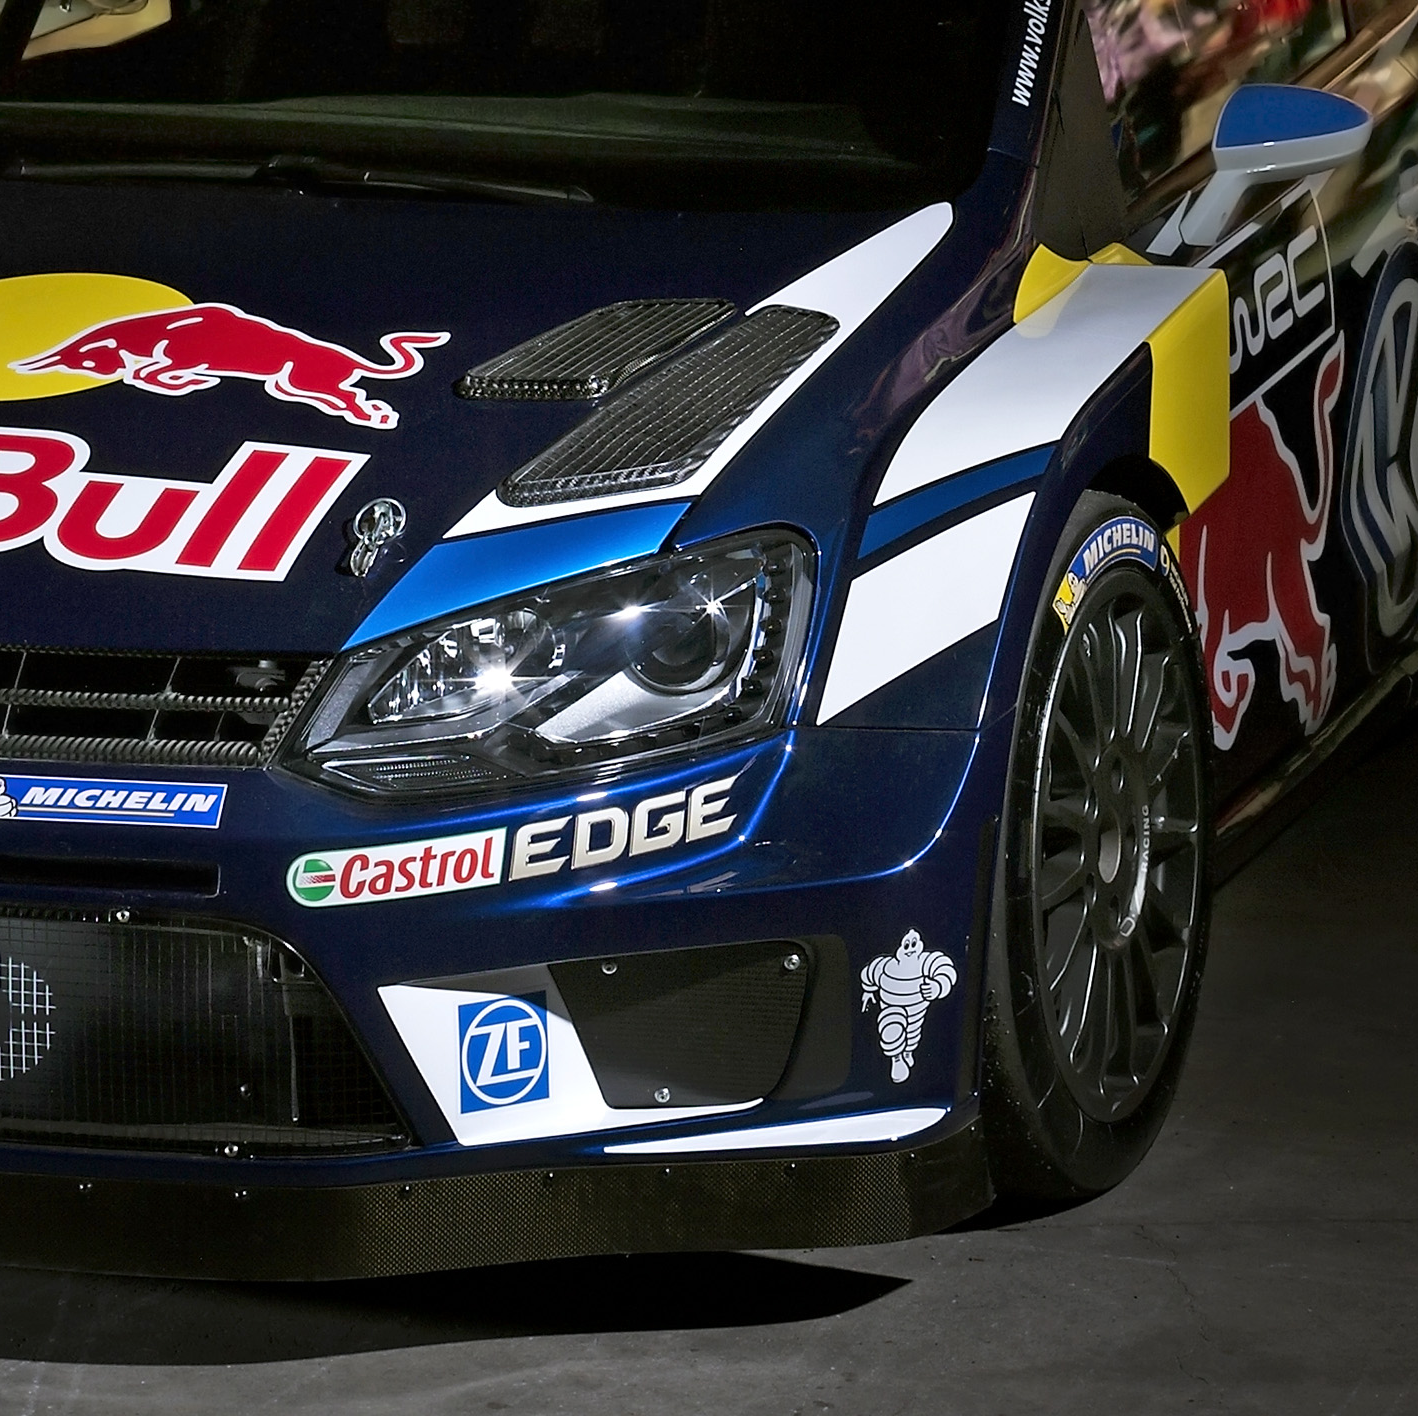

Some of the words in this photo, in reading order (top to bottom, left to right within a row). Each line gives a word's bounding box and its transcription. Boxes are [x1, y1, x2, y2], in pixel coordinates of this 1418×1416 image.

[1083, 522, 1155, 577] MICHELIN
[20, 786, 218, 812] MICHELIN
[339, 837, 495, 900] Castrol
[509, 774, 741, 882] EDGE
[468, 1015, 541, 1088] ZF
